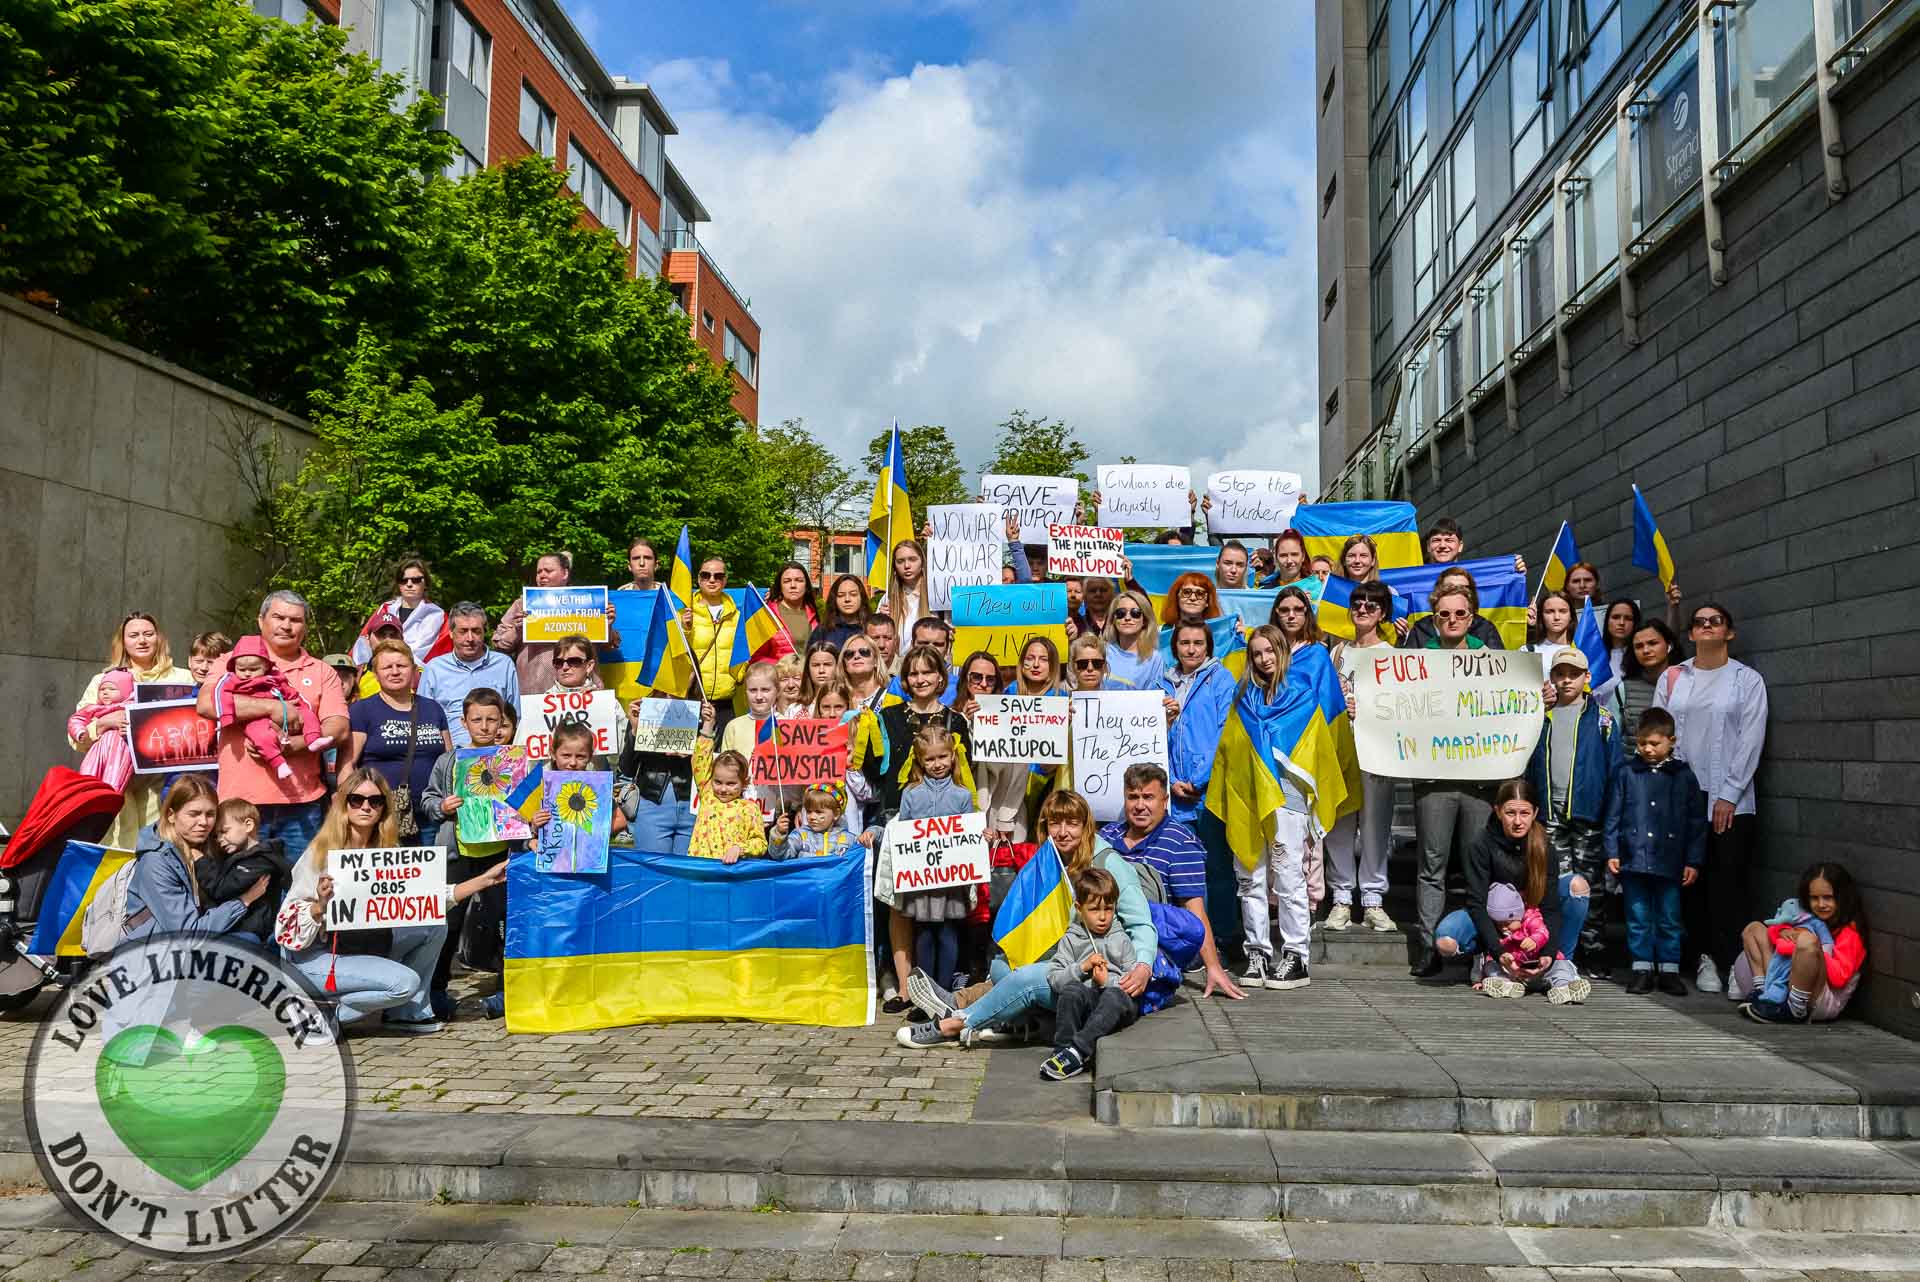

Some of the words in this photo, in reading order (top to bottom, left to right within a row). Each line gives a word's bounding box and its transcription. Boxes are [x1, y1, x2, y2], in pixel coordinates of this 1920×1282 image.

[1218, 475, 1256, 497] Stop
[1268, 476, 1296, 495] the
[1221, 499, 1284, 521] Murder
[1049, 524, 1124, 541] EXTRACTION
[1052, 538, 1071, 550] THE
[1073, 540, 1122, 552] MILITARY
[1076, 550, 1092, 559] OF
[1049, 557, 1122, 575] MARIUPOL
[530, 608, 573, 618] MILITARY
[575, 608, 601, 618] FROM
[959, 591, 1014, 617] They
[544, 622, 588, 633] AZOVSTAL
[1374, 655, 1428, 684] FUCK
[543, 690, 593, 713] STOP
[999, 697, 1043, 713] SAVE
[1374, 689, 1446, 720] SAVE
[977, 715, 999, 726] THE
[1010, 714, 1067, 726] MILITARY
[1073, 697, 1124, 739] They
[1130, 714, 1158, 728] are
[779, 723, 829, 746] SAVE
[1011, 725, 1028, 736] OF
[973, 739, 1063, 758] MARIUPOL
[1077, 734, 1110, 760] The
[1116, 734, 1163, 759] Best
[755, 755, 843, 780] AZOVSTAL
[912, 815, 964, 839] SAVE
[895, 841, 921, 855] THE
[926, 833, 983, 851] MILITARY
[340, 853, 364, 869] MY
[371, 849, 436, 867] FRIEND
[926, 850, 943, 866] OF
[353, 869, 370, 882] IS
[375, 867, 422, 881] KILLED
[895, 863, 983, 889] MARIUPOL
[370, 880, 406, 895] 08.05
[331, 898, 357, 925] IN
[365, 894, 445, 922] AZOVSTAL
